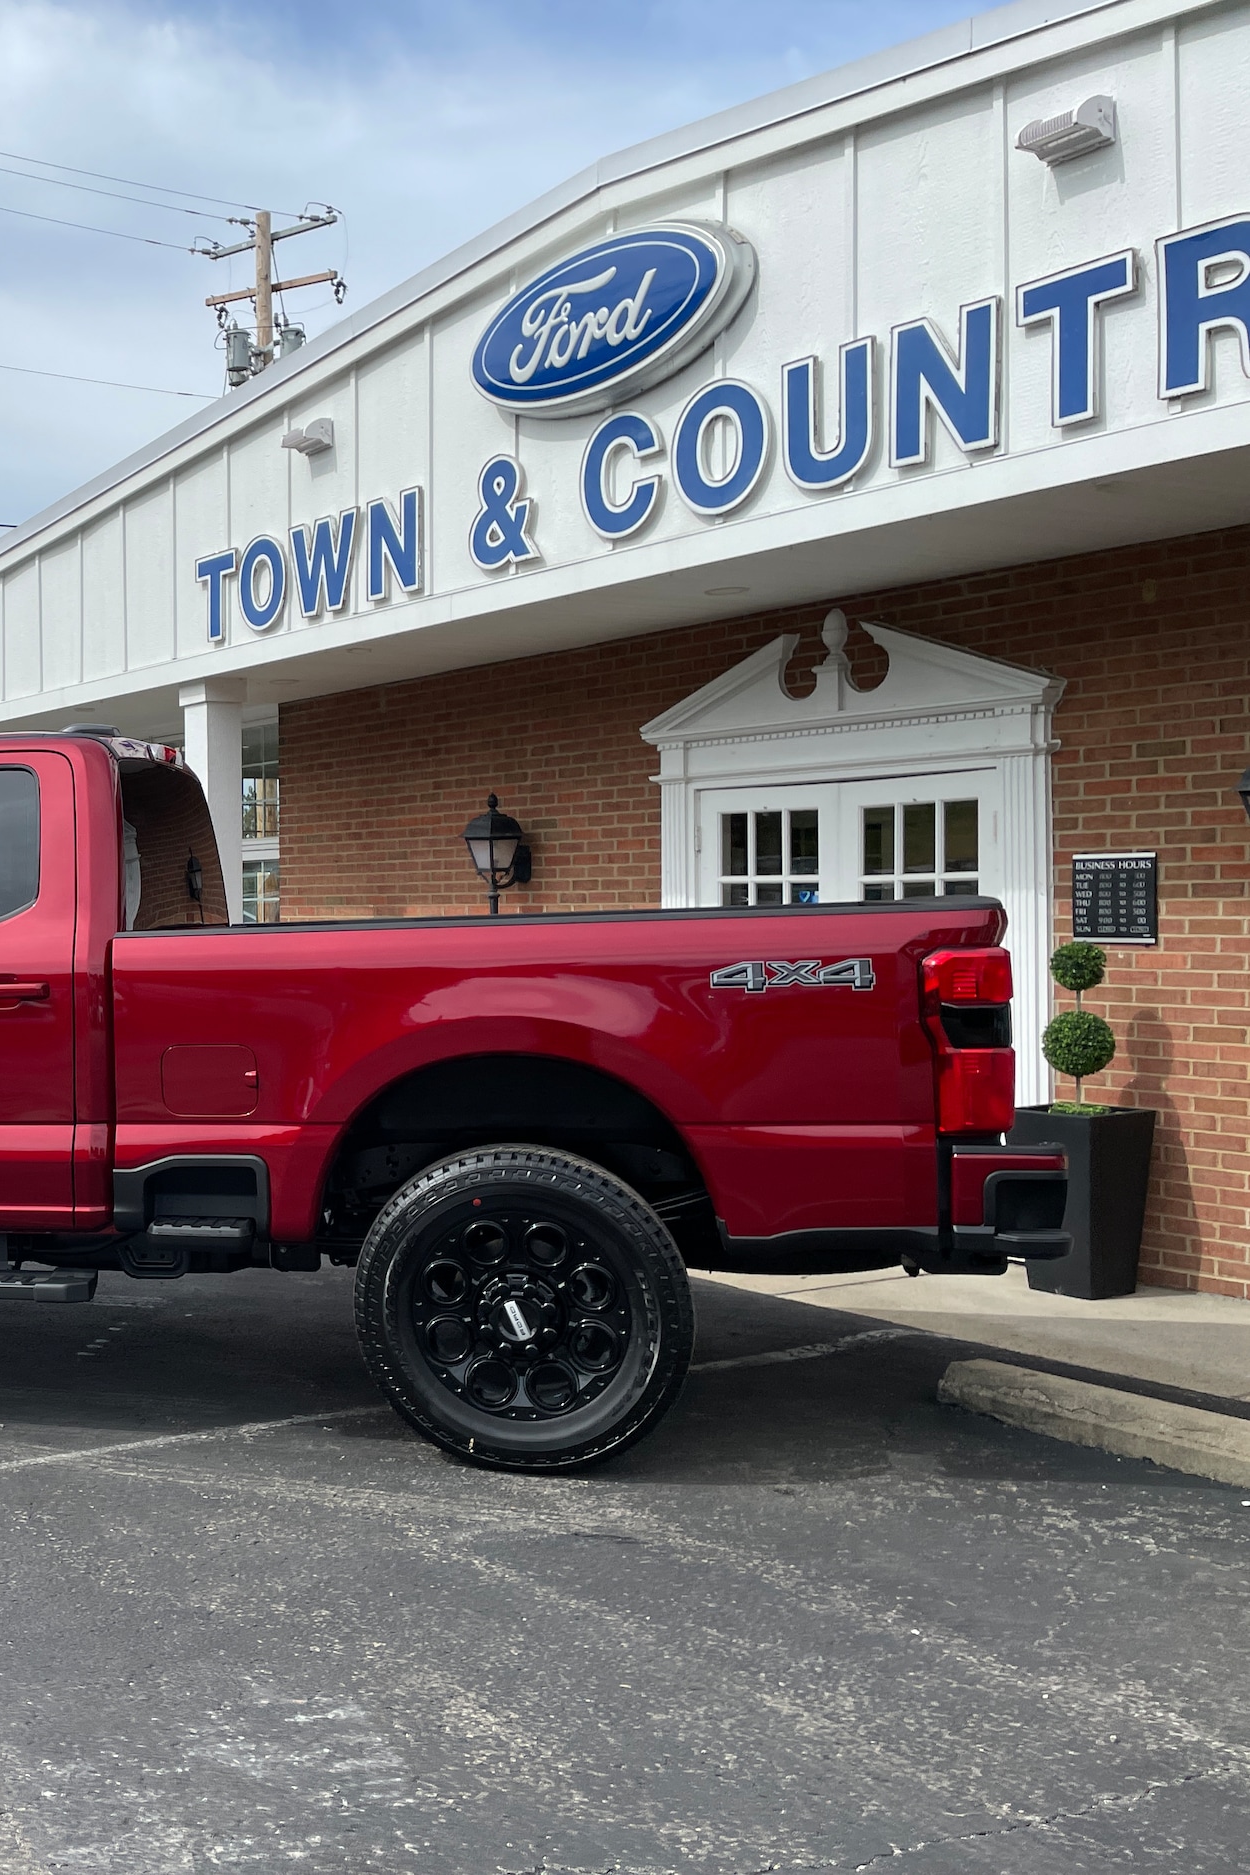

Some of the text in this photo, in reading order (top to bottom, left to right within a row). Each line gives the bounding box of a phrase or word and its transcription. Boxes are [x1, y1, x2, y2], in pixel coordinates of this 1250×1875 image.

[509, 266, 657, 384] Ford
[195, 486, 422, 642] TOWN
[469, 454, 539, 571] &
[1076, 860, 1151, 870] BUSINESS HOURS
